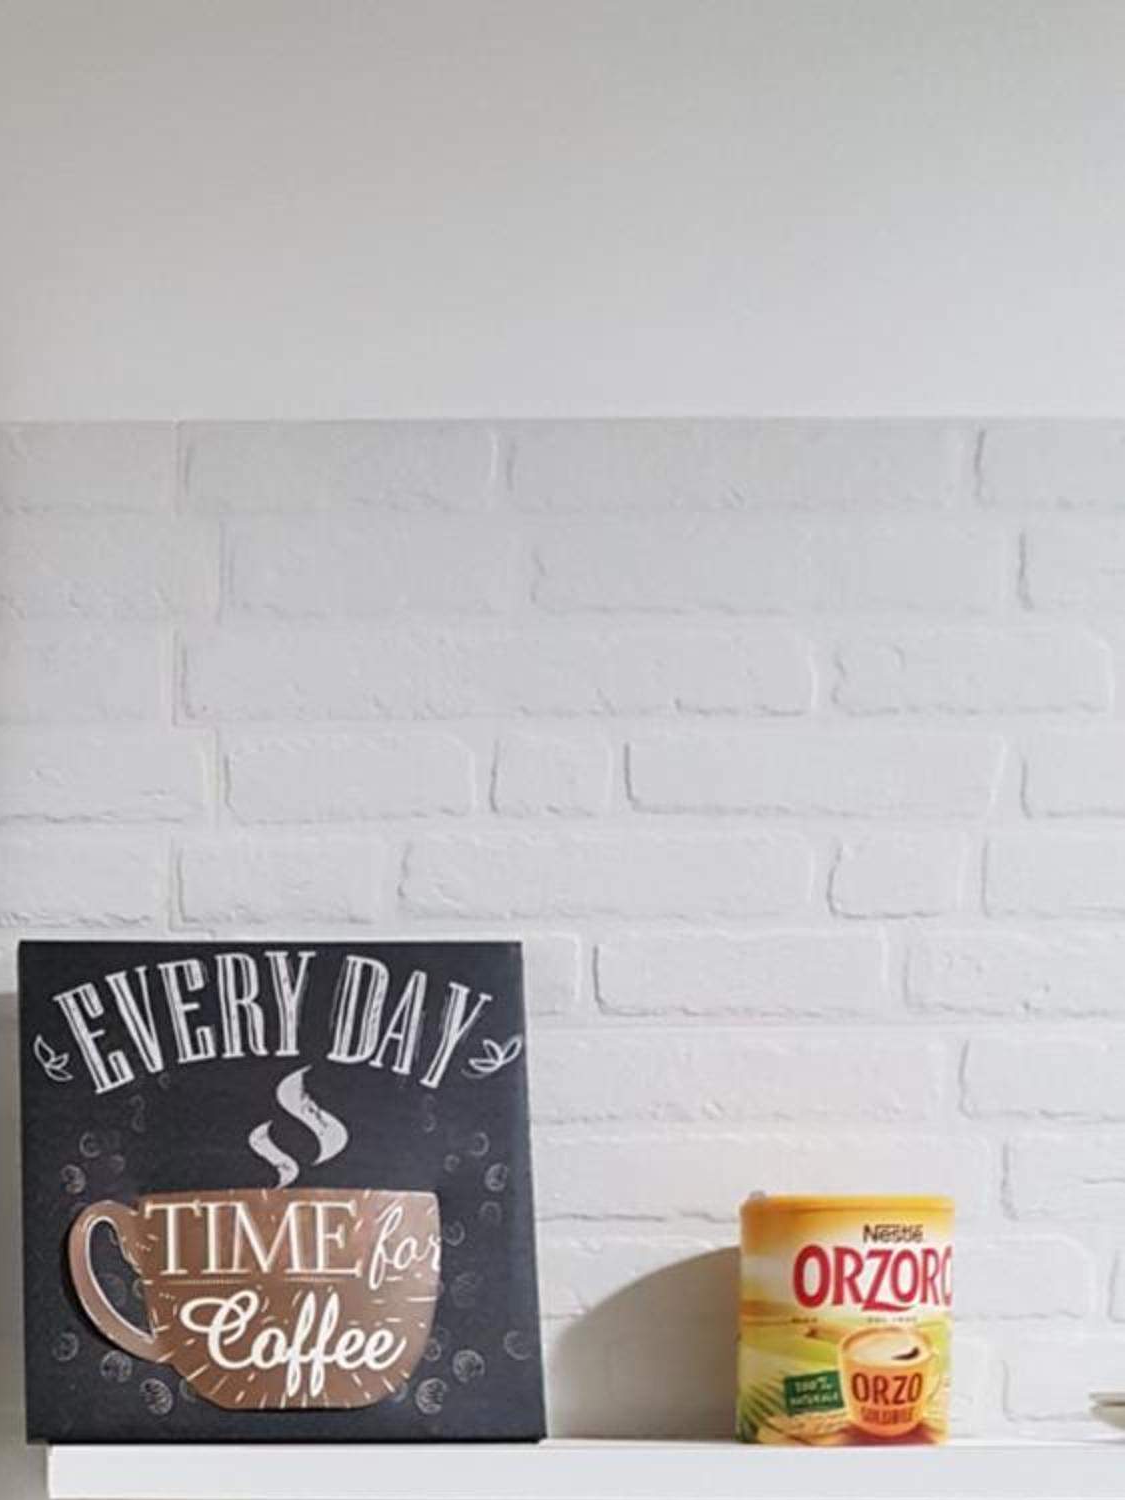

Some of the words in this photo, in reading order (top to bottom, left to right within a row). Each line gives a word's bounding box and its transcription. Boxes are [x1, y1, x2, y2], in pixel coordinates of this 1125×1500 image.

[53, 950, 316, 1094] EVERY
[327, 955, 492, 1089] DAY
[144, 1201, 363, 1278] TIME
[368, 1205, 442, 1290] for
[179, 1290, 407, 1398] Coffee
[850, 1371, 924, 1406] ORZO
